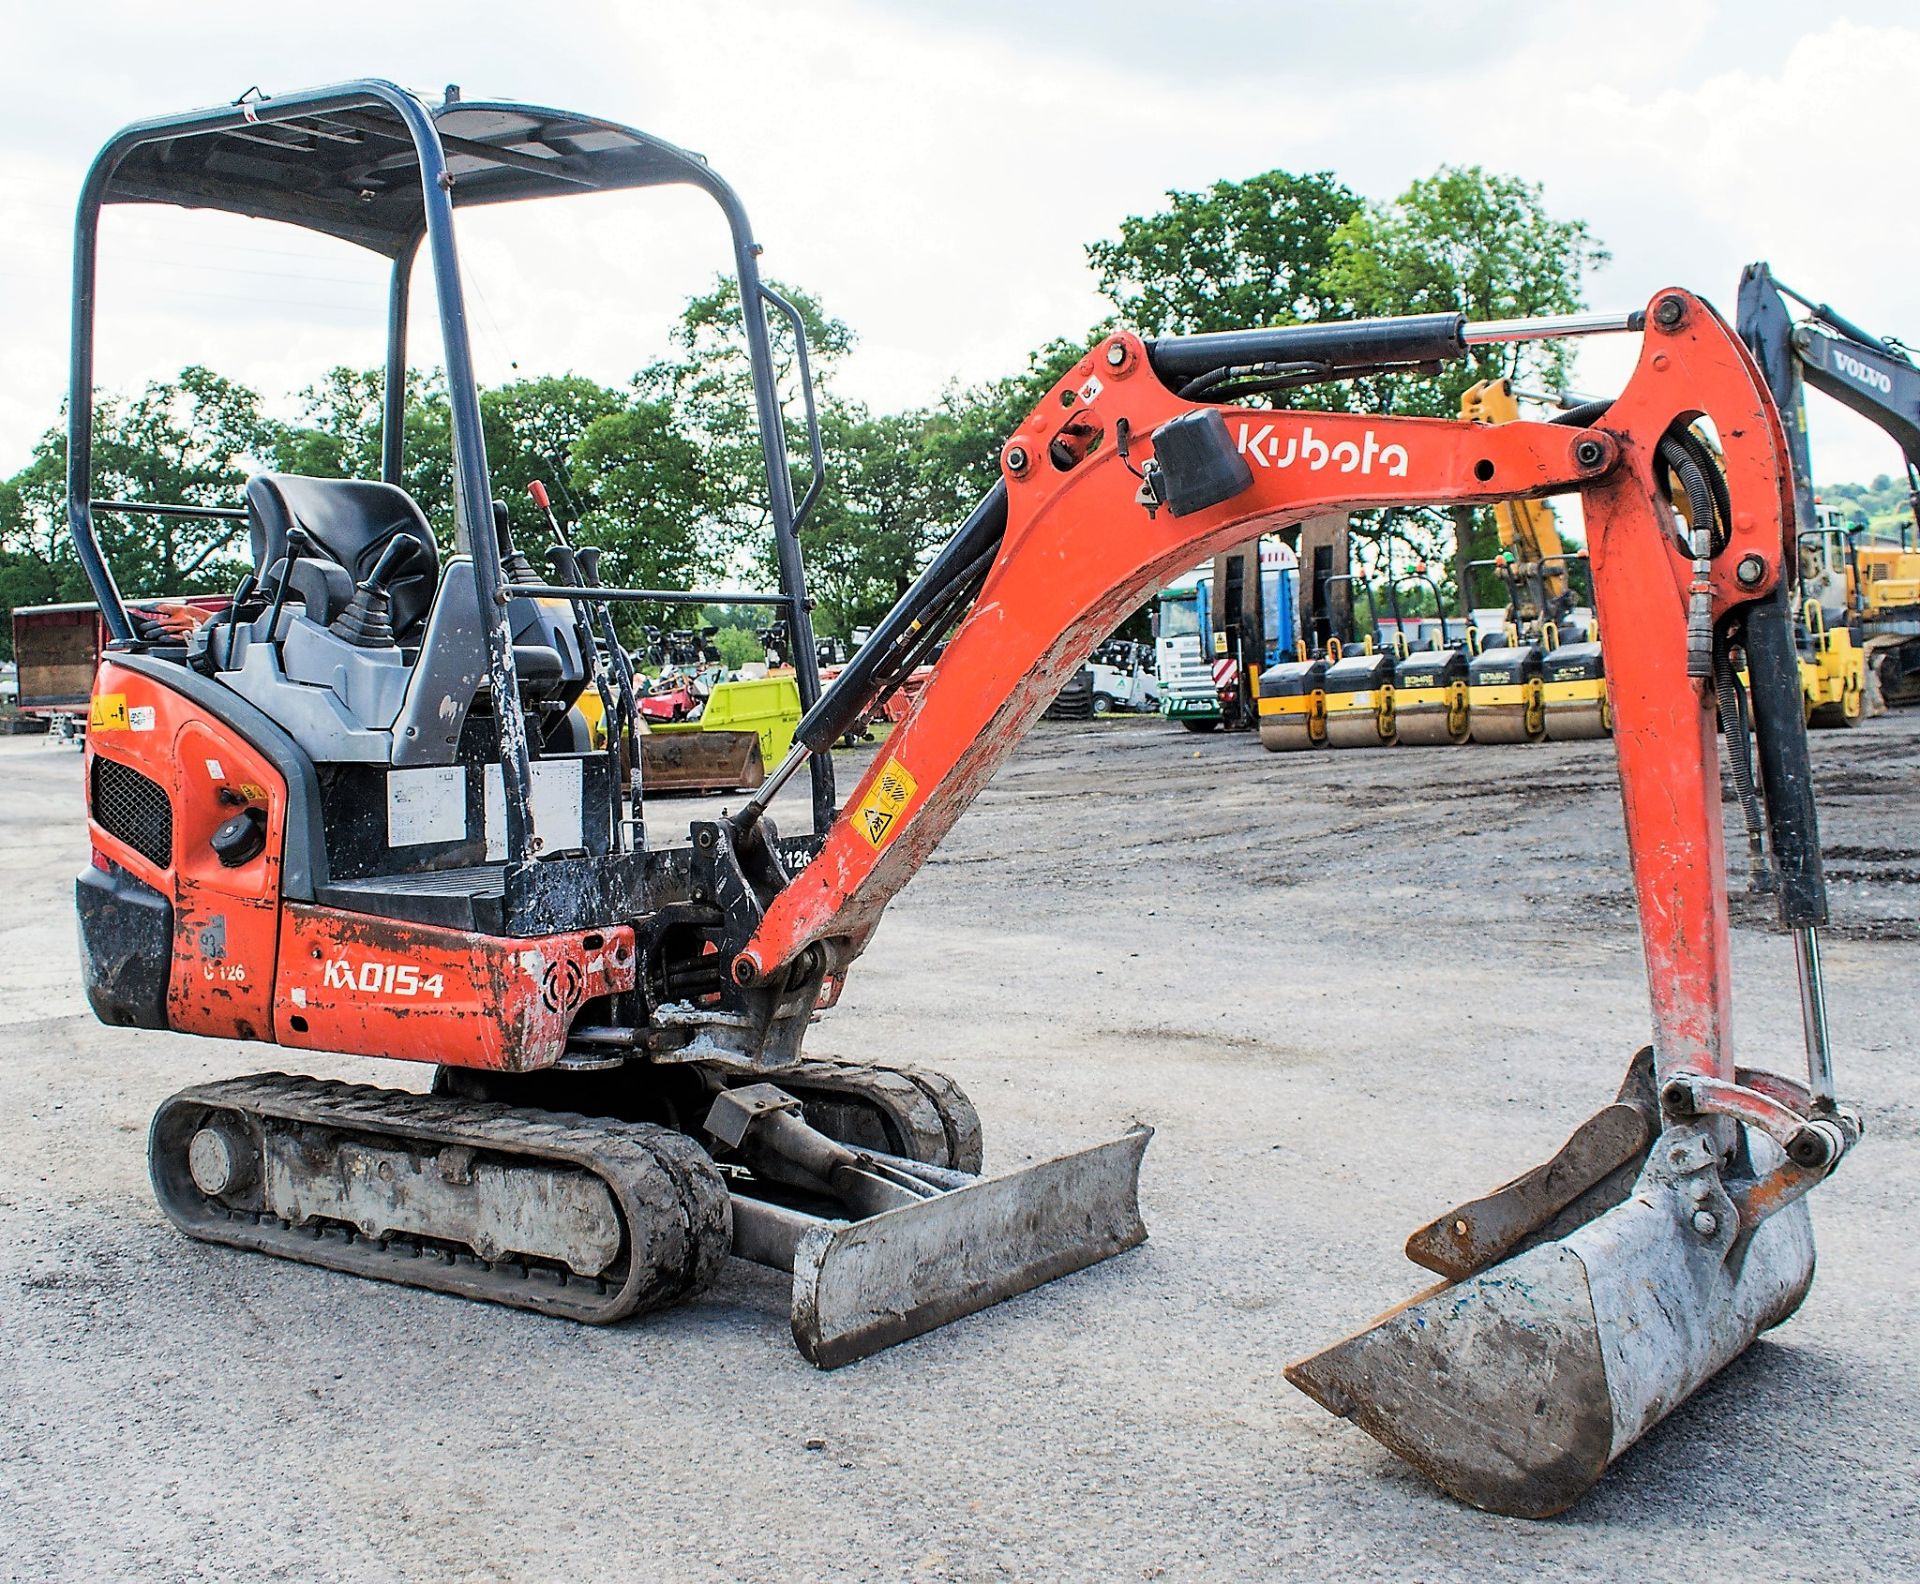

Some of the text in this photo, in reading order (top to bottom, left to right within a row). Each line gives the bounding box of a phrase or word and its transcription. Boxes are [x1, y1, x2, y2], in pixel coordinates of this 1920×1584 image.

[1833, 349, 1892, 393] VOLVO
[1237, 423, 1409, 477] Kubota
[323, 959, 444, 998] KX015-4
